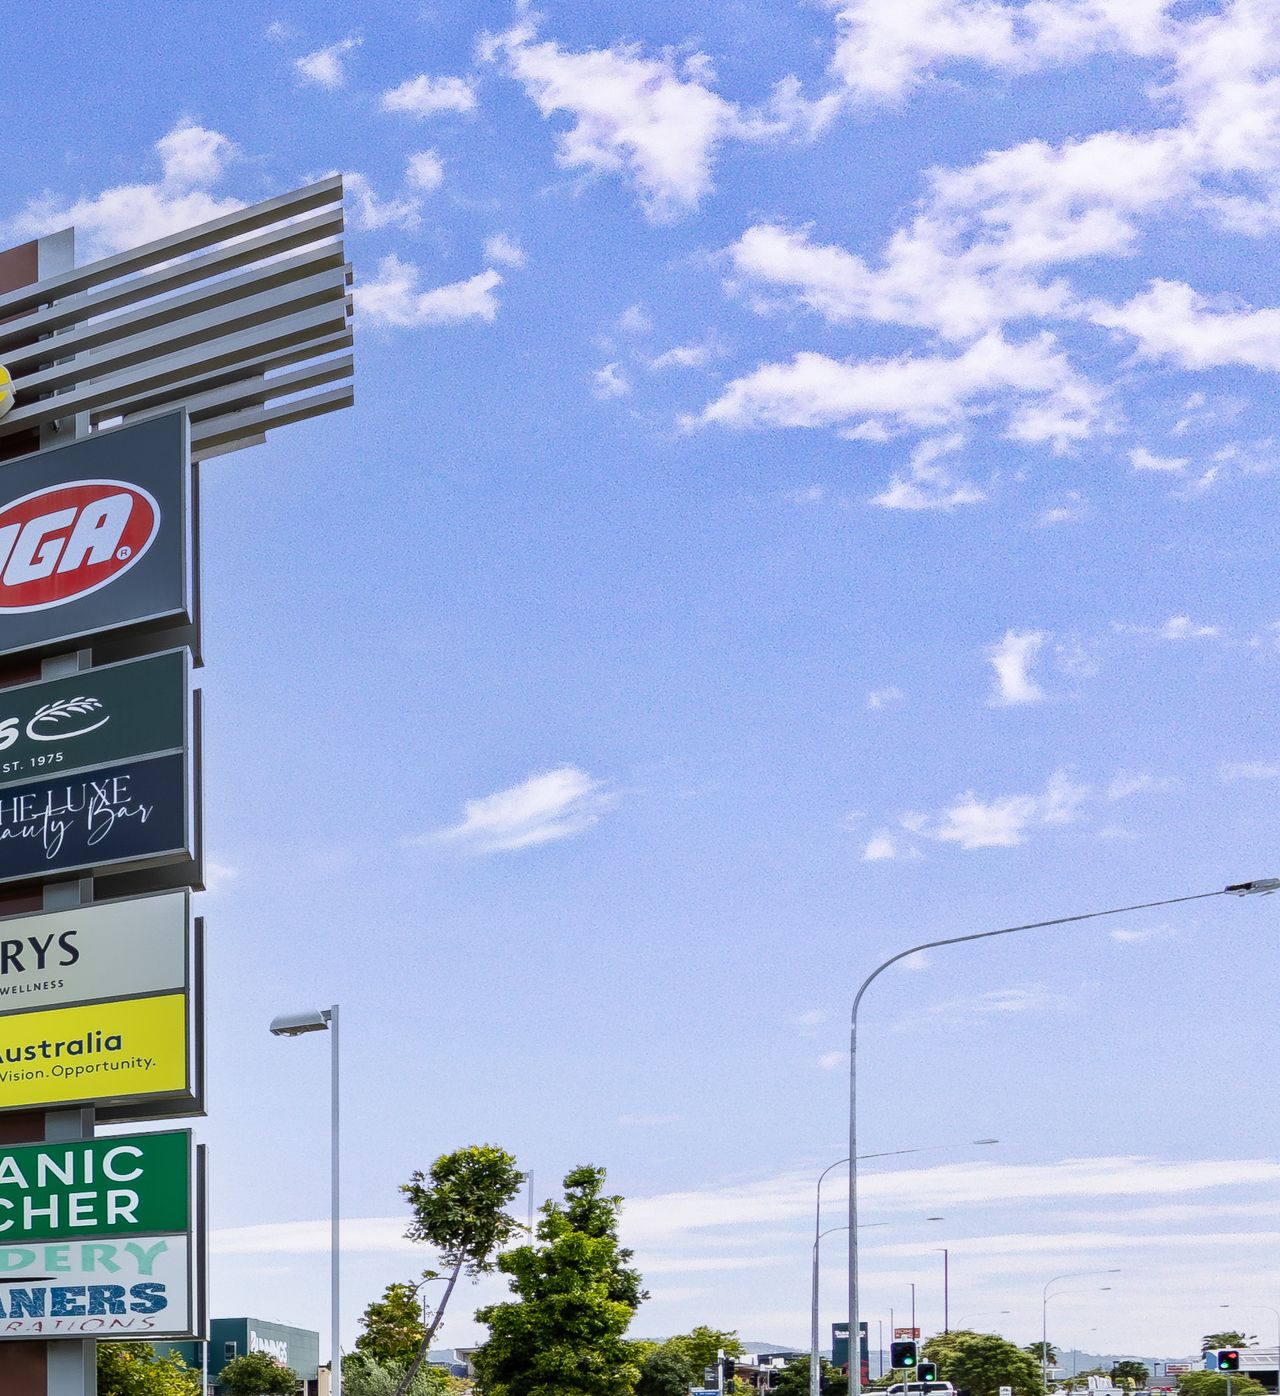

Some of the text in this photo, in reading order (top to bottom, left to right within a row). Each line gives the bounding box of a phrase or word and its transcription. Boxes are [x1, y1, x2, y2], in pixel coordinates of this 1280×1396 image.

[30, 752, 64, 767] 1975
[46, 775, 132, 814] LUXE
[86, 791, 154, 846] Bar
[0, 979, 65, 996] WELLNESS
[51, 1055, 157, 1079] Opportunity.
